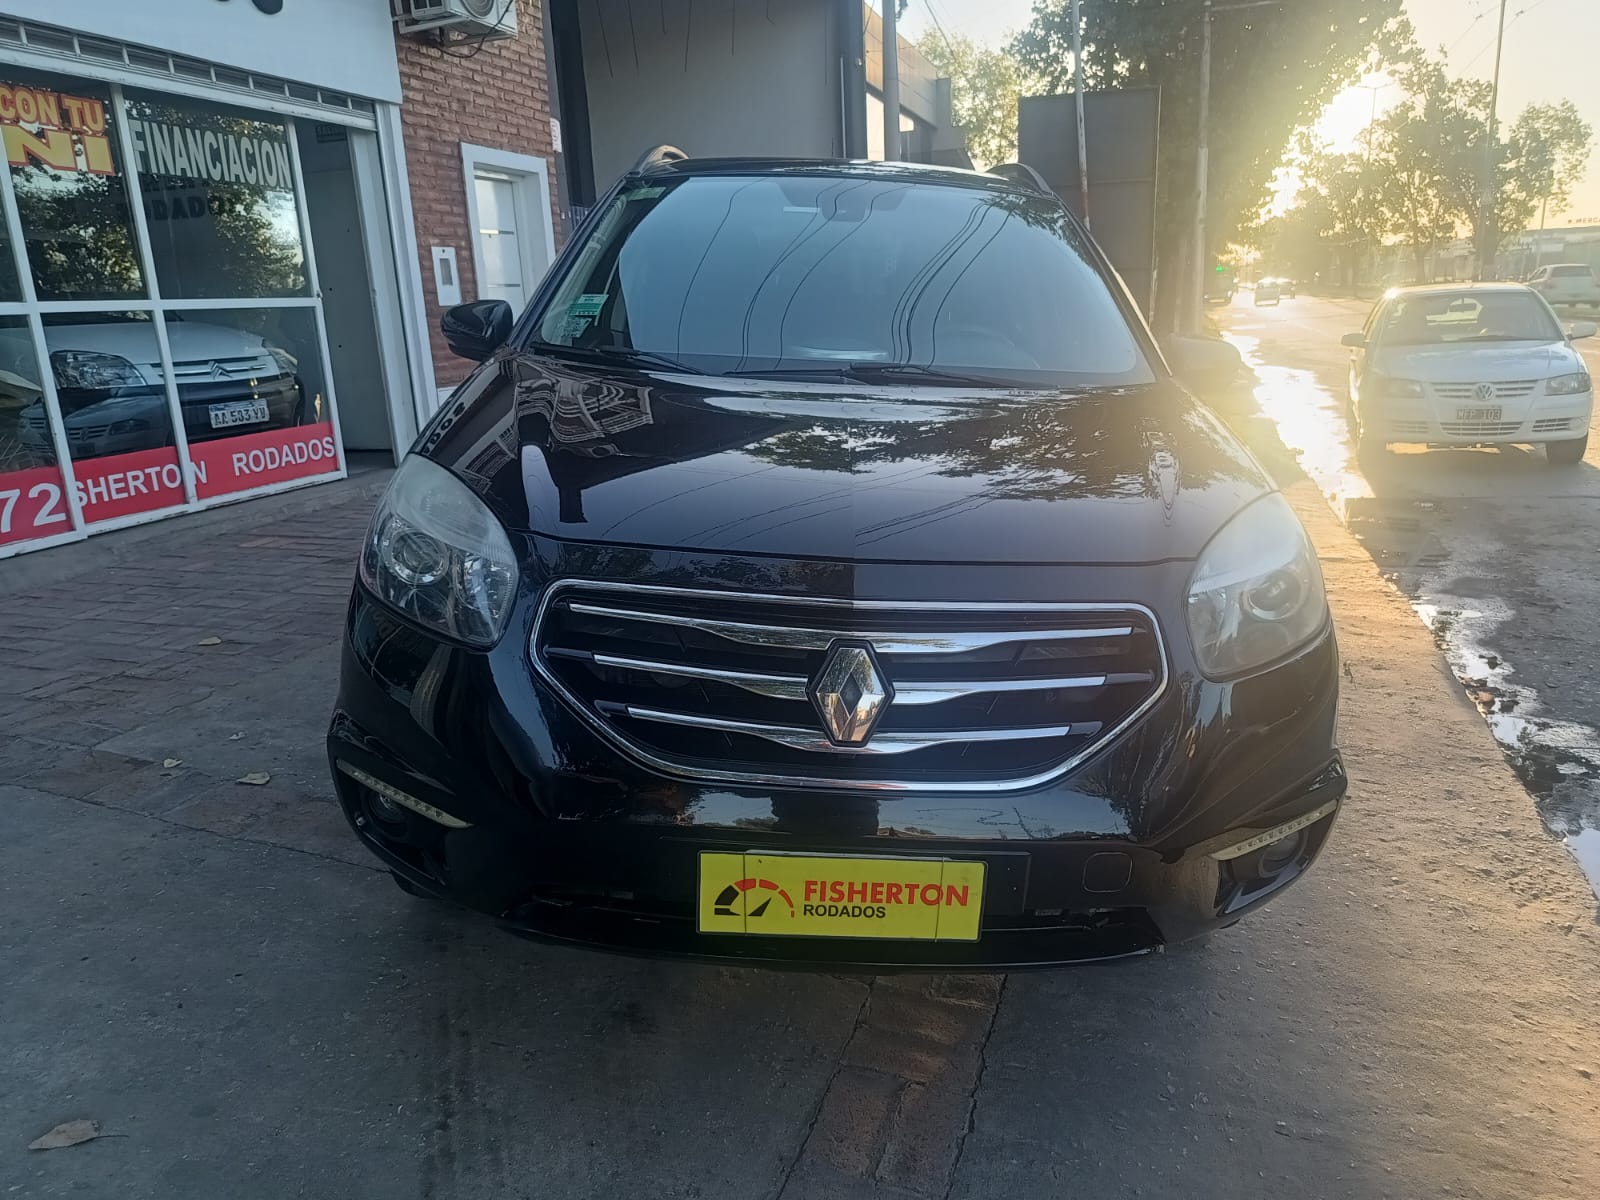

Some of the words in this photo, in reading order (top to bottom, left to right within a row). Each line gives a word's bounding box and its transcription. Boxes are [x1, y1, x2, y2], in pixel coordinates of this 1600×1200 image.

[0, 83, 60, 125] CON
[61, 93, 105, 133] TU
[128, 119, 293, 189] FINANCIACION
[232, 435, 336, 477] RODADOS
[803, 904, 886, 919] RODADOS
[804, 880, 969, 906] FISHERTON
